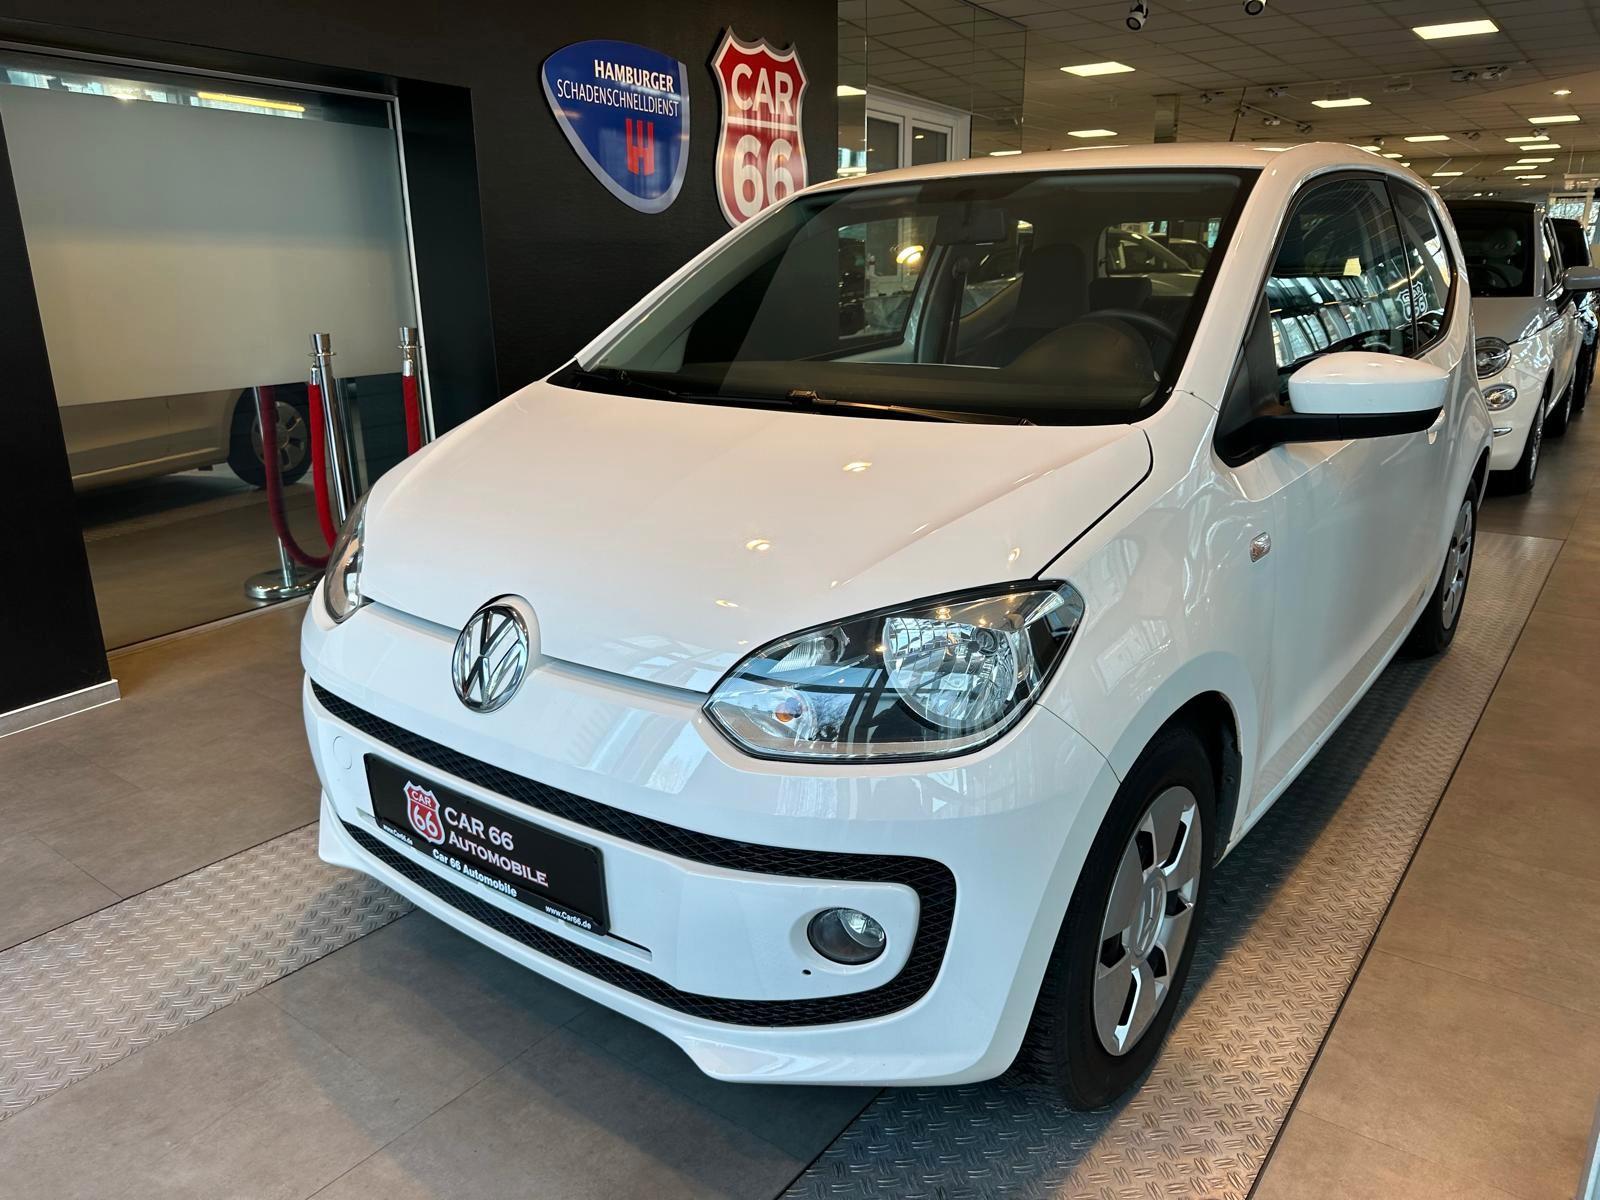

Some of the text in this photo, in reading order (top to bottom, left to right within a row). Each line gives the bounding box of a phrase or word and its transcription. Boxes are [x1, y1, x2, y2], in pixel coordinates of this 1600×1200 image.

[594, 59, 675, 94] HAMBURGER
[731, 63, 794, 117] CAR
[556, 78, 679, 118] SCHADENSCHNELLDIENST
[733, 134, 794, 218] 66
[411, 790, 432, 808] CAR
[413, 804, 438, 838] 66
[444, 806, 515, 851] CAR 66
[432, 848, 518, 898] Car 66 Automobile
[448, 831, 549, 888] AUTOMOBILE
[545, 905, 592, 930] www.Car66.de
